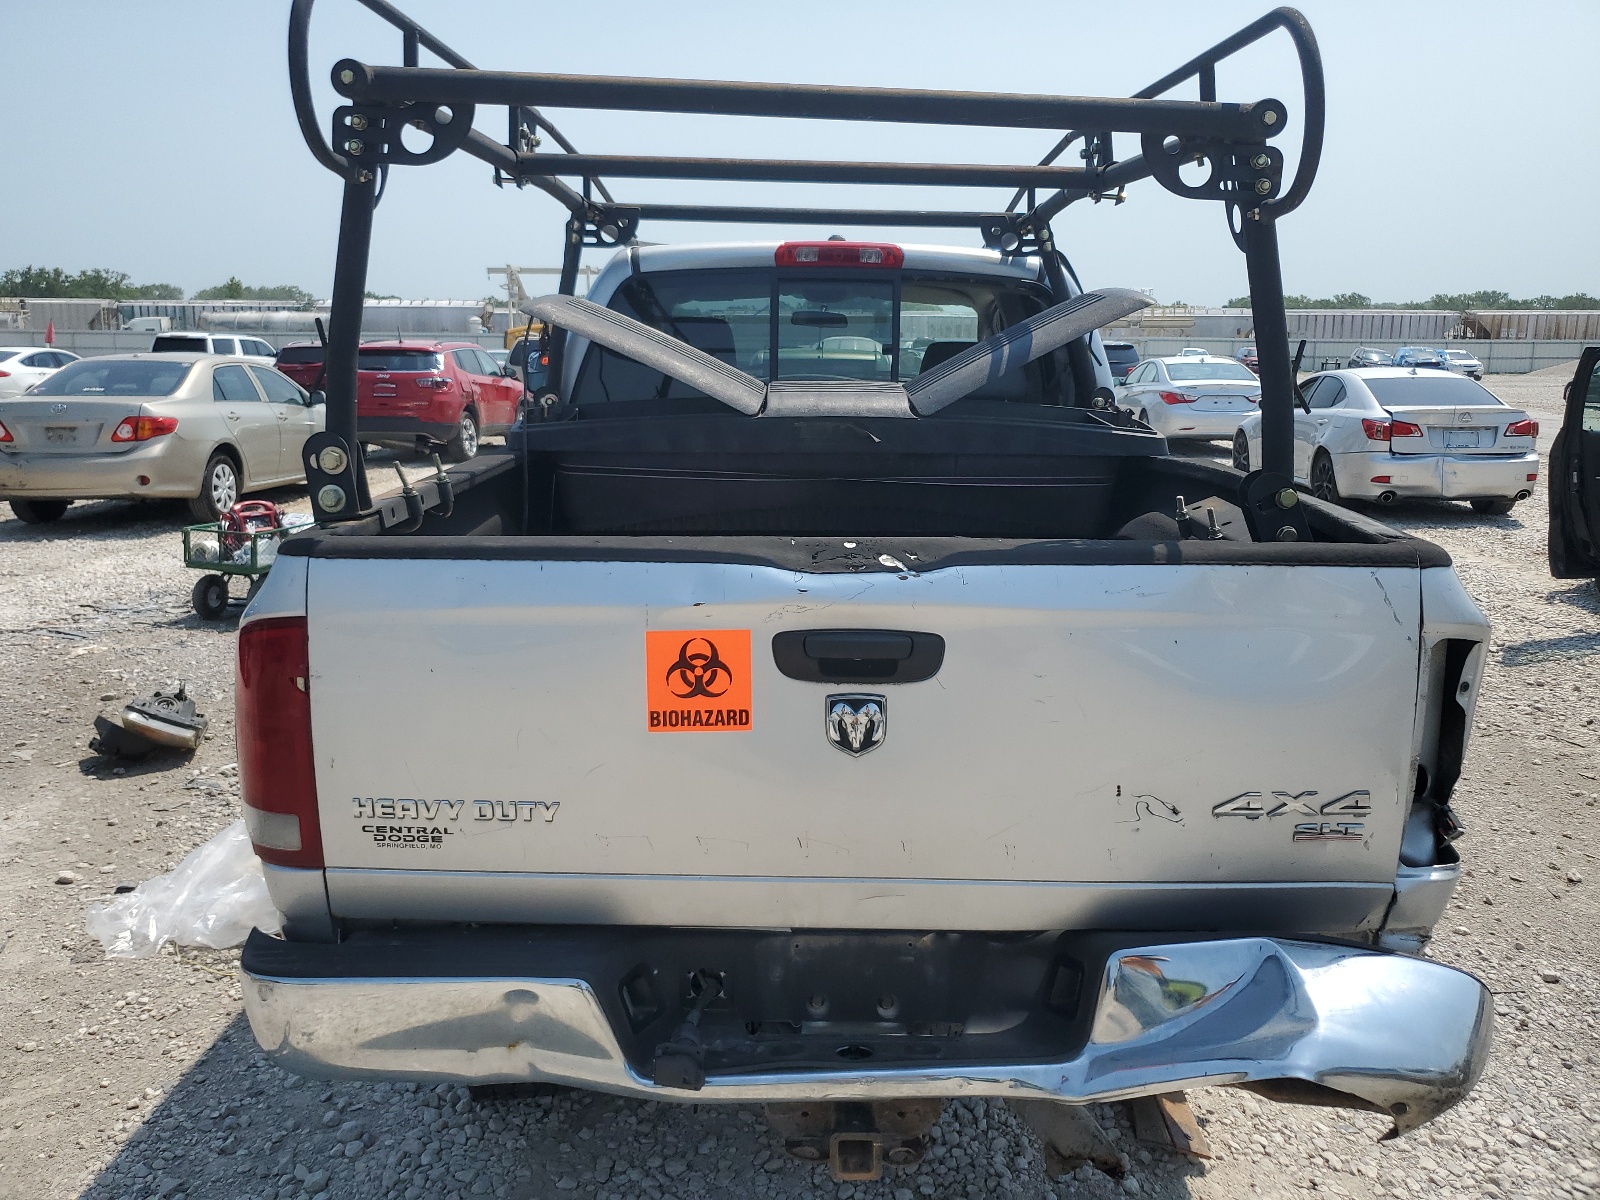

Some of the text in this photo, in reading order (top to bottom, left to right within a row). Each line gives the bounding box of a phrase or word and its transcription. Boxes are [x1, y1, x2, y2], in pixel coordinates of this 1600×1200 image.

[650, 709, 749, 727] BIOHAZARD
[352, 797, 561, 823] HEAVY DUTY
[361, 824, 455, 836] CENTRAL
[1294, 822, 1366, 839] SLT
[373, 833, 444, 843] DODGE
[376, 842, 428, 850] SPRINGFIELD,
